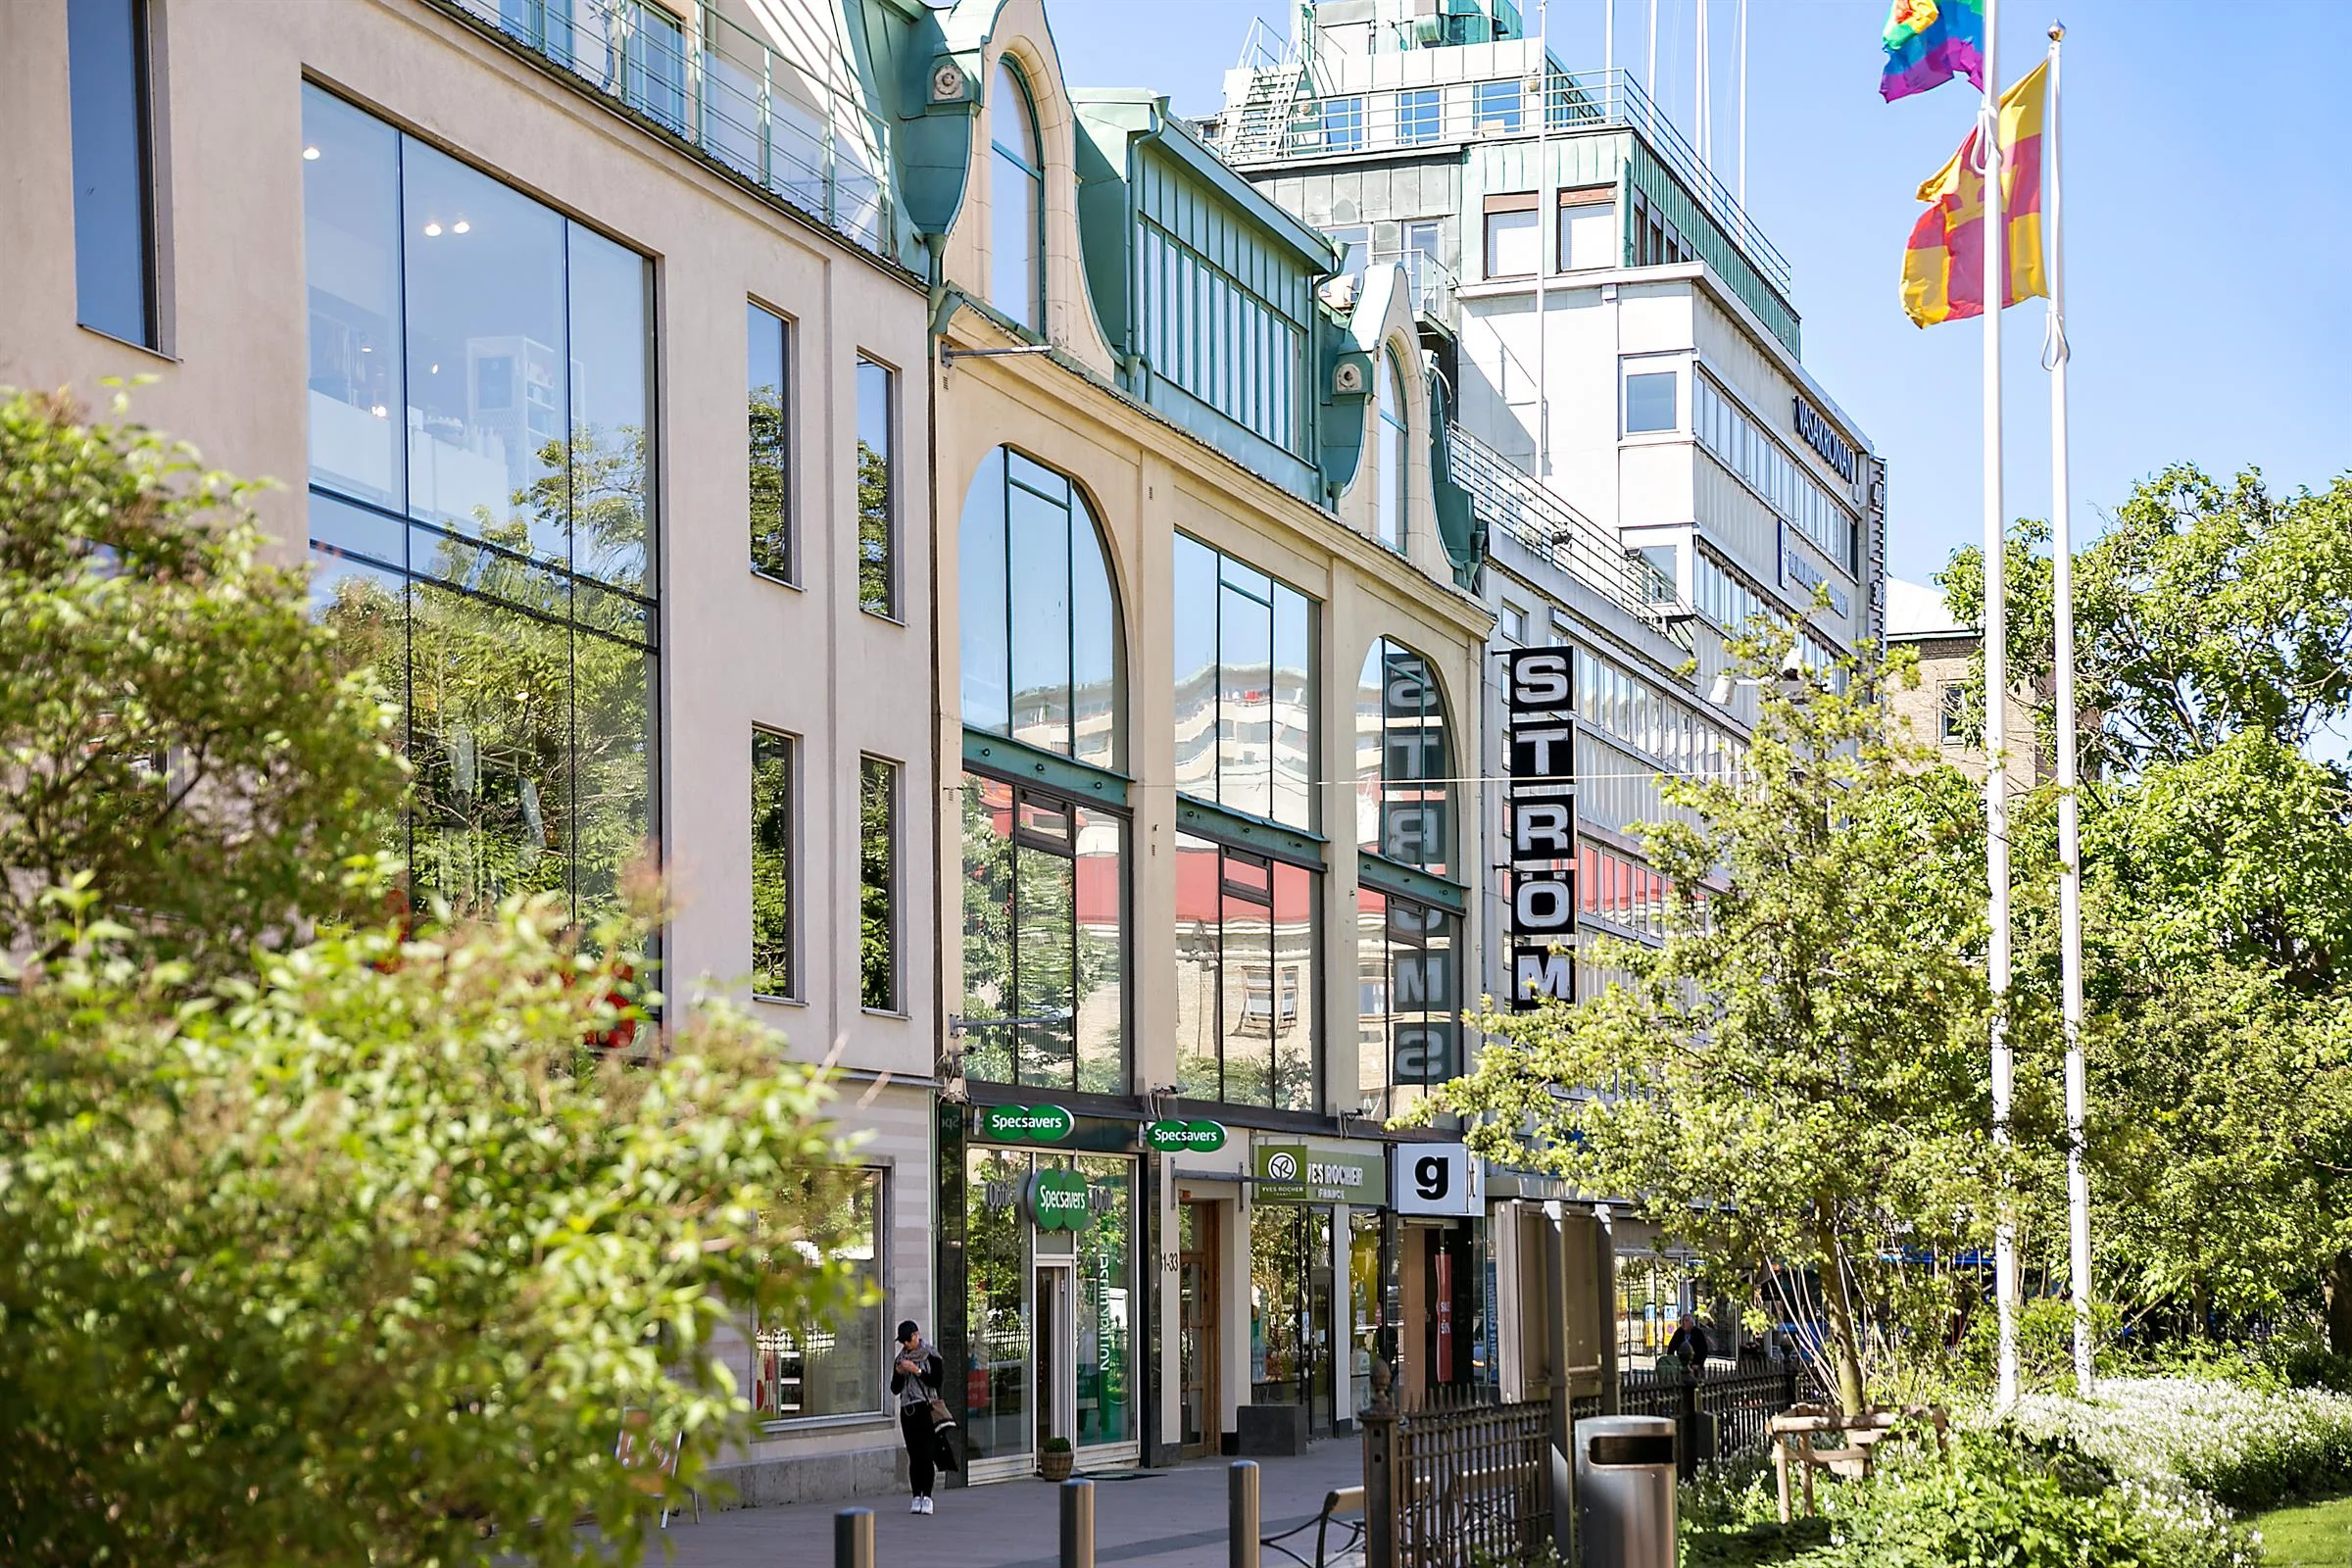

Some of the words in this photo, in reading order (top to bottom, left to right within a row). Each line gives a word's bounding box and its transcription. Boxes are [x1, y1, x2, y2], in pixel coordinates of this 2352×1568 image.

[1796, 396, 1853, 484] VASAKRONAN
[992, 1114, 1062, 1130] Specsavers
[1154, 1129, 1217, 1143] Specsavers
[1414, 1155, 1449, 1200] g
[1040, 1184, 1086, 1212] Specsavers
